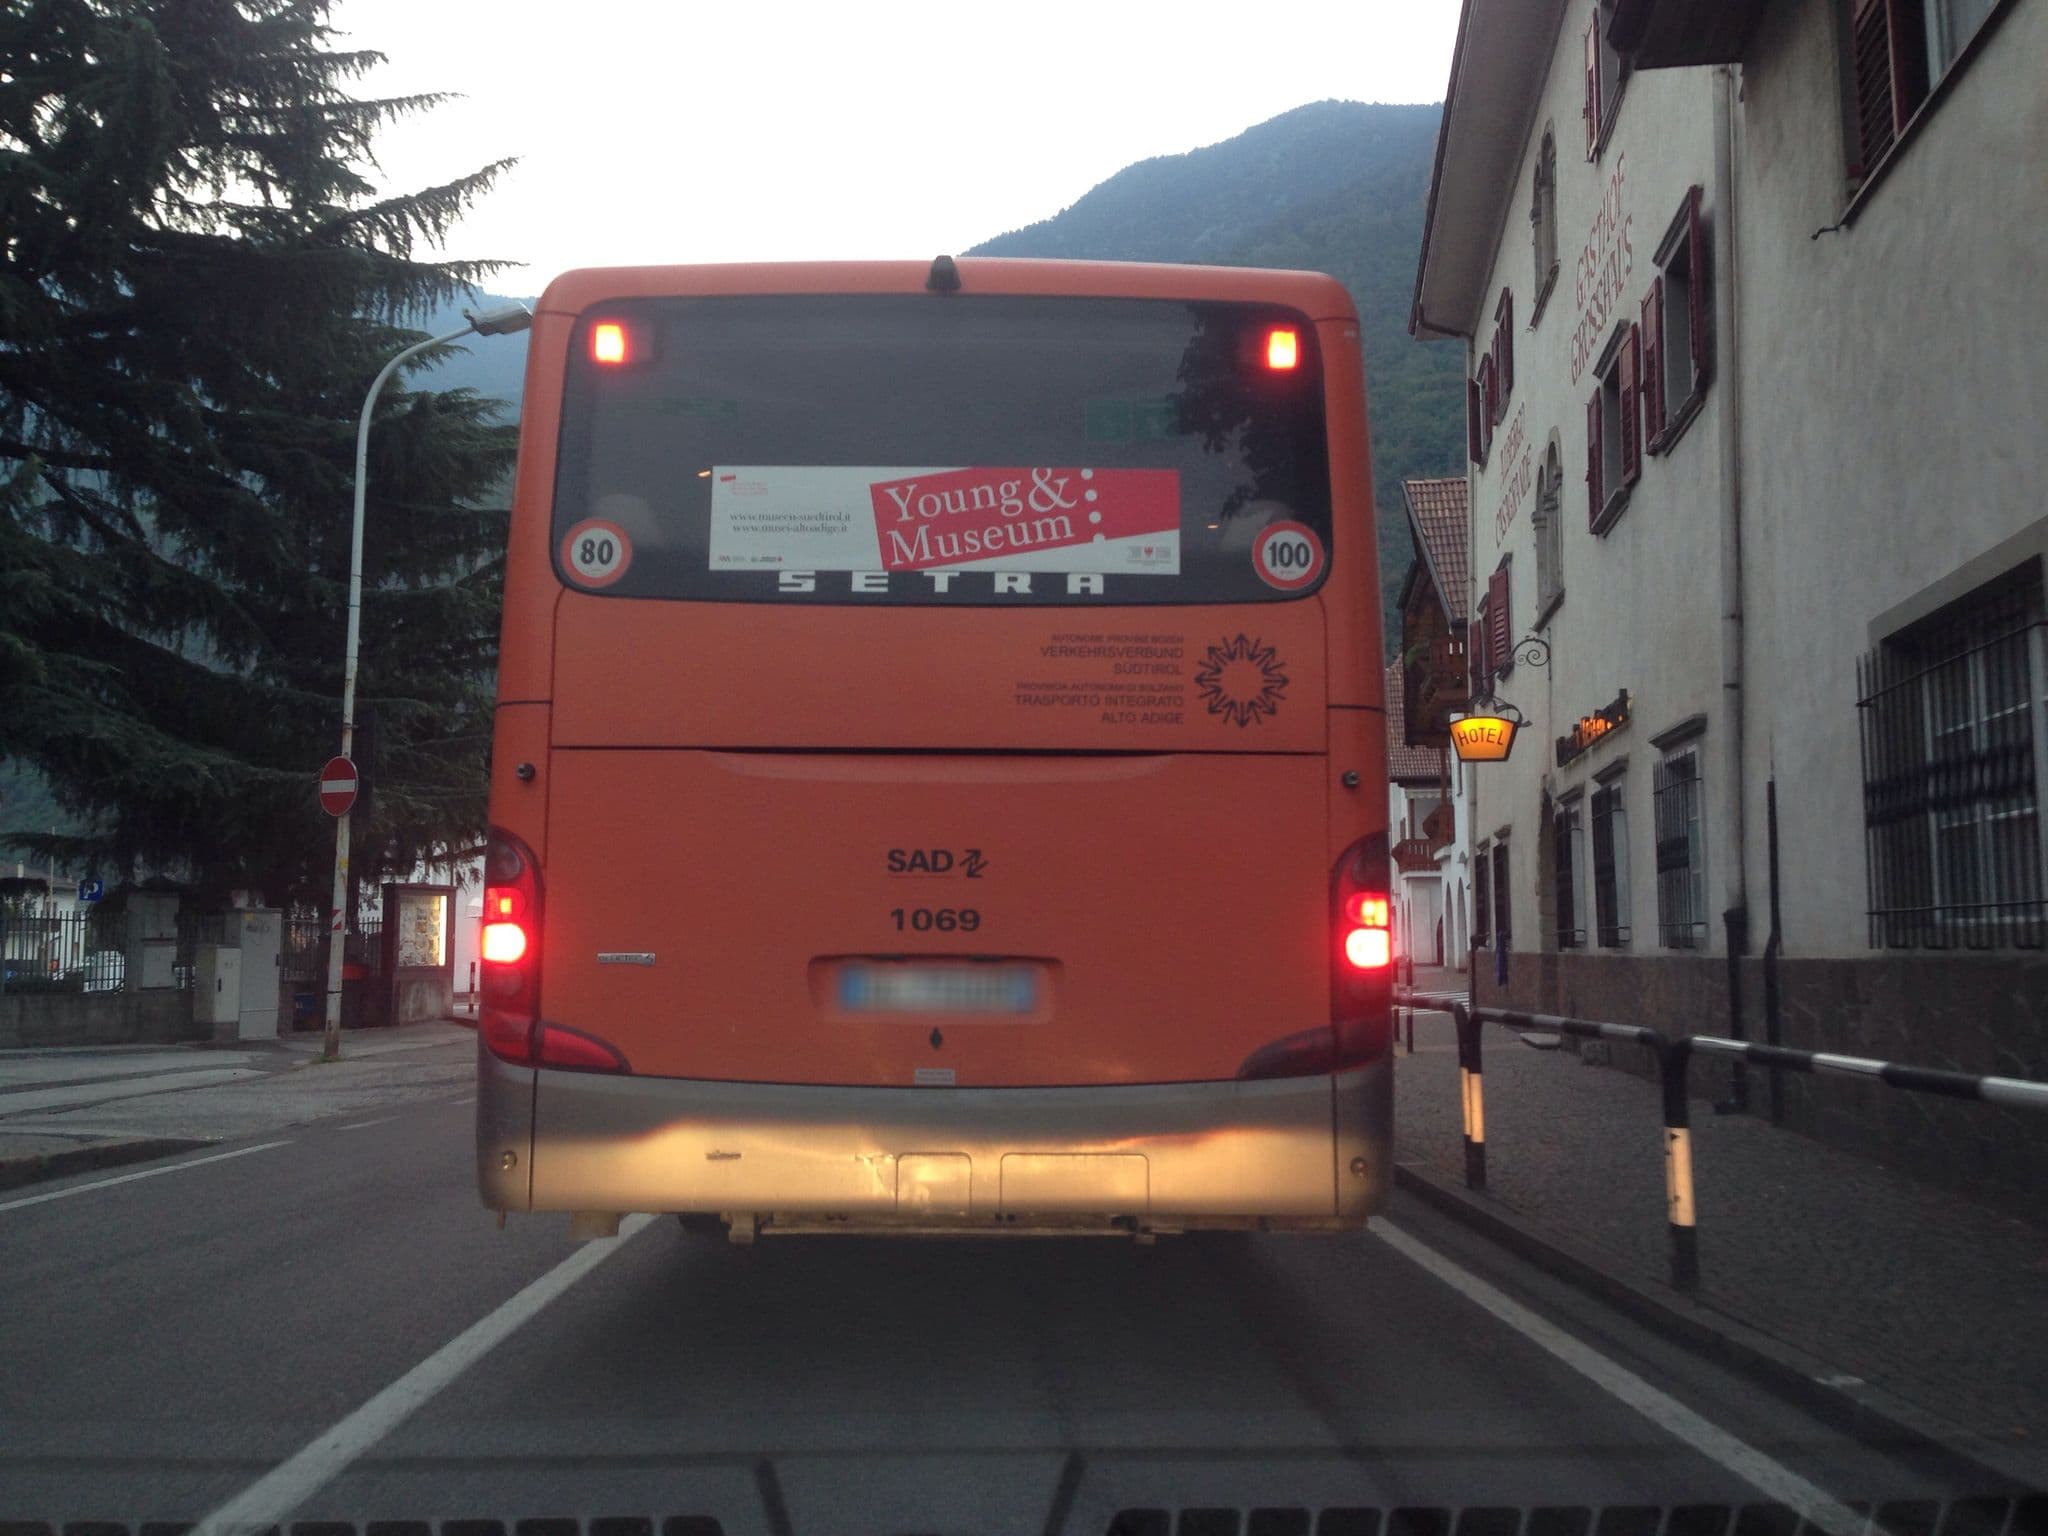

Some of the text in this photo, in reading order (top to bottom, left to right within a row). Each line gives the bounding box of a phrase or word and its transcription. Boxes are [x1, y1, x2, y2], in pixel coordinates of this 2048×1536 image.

[1576, 151, 1625, 312] GASTHOF
[581, 538, 614, 566] 80
[887, 514, 1075, 566] Museum
[1268, 541, 1310, 568] 100
[778, 570, 1104, 595] SETRA
[1040, 646, 1183, 658] VERKEHRSVERBUND
[1113, 662, 1184, 675] SÜDTIROL
[1015, 695, 1184, 708] TRASPORTO INTEGRATO
[1101, 712, 1184, 724] ALTO ADIGE
[1457, 727, 1505, 747] HOTEL
[887, 848, 954, 873] SAD
[891, 908, 981, 932] 1069
